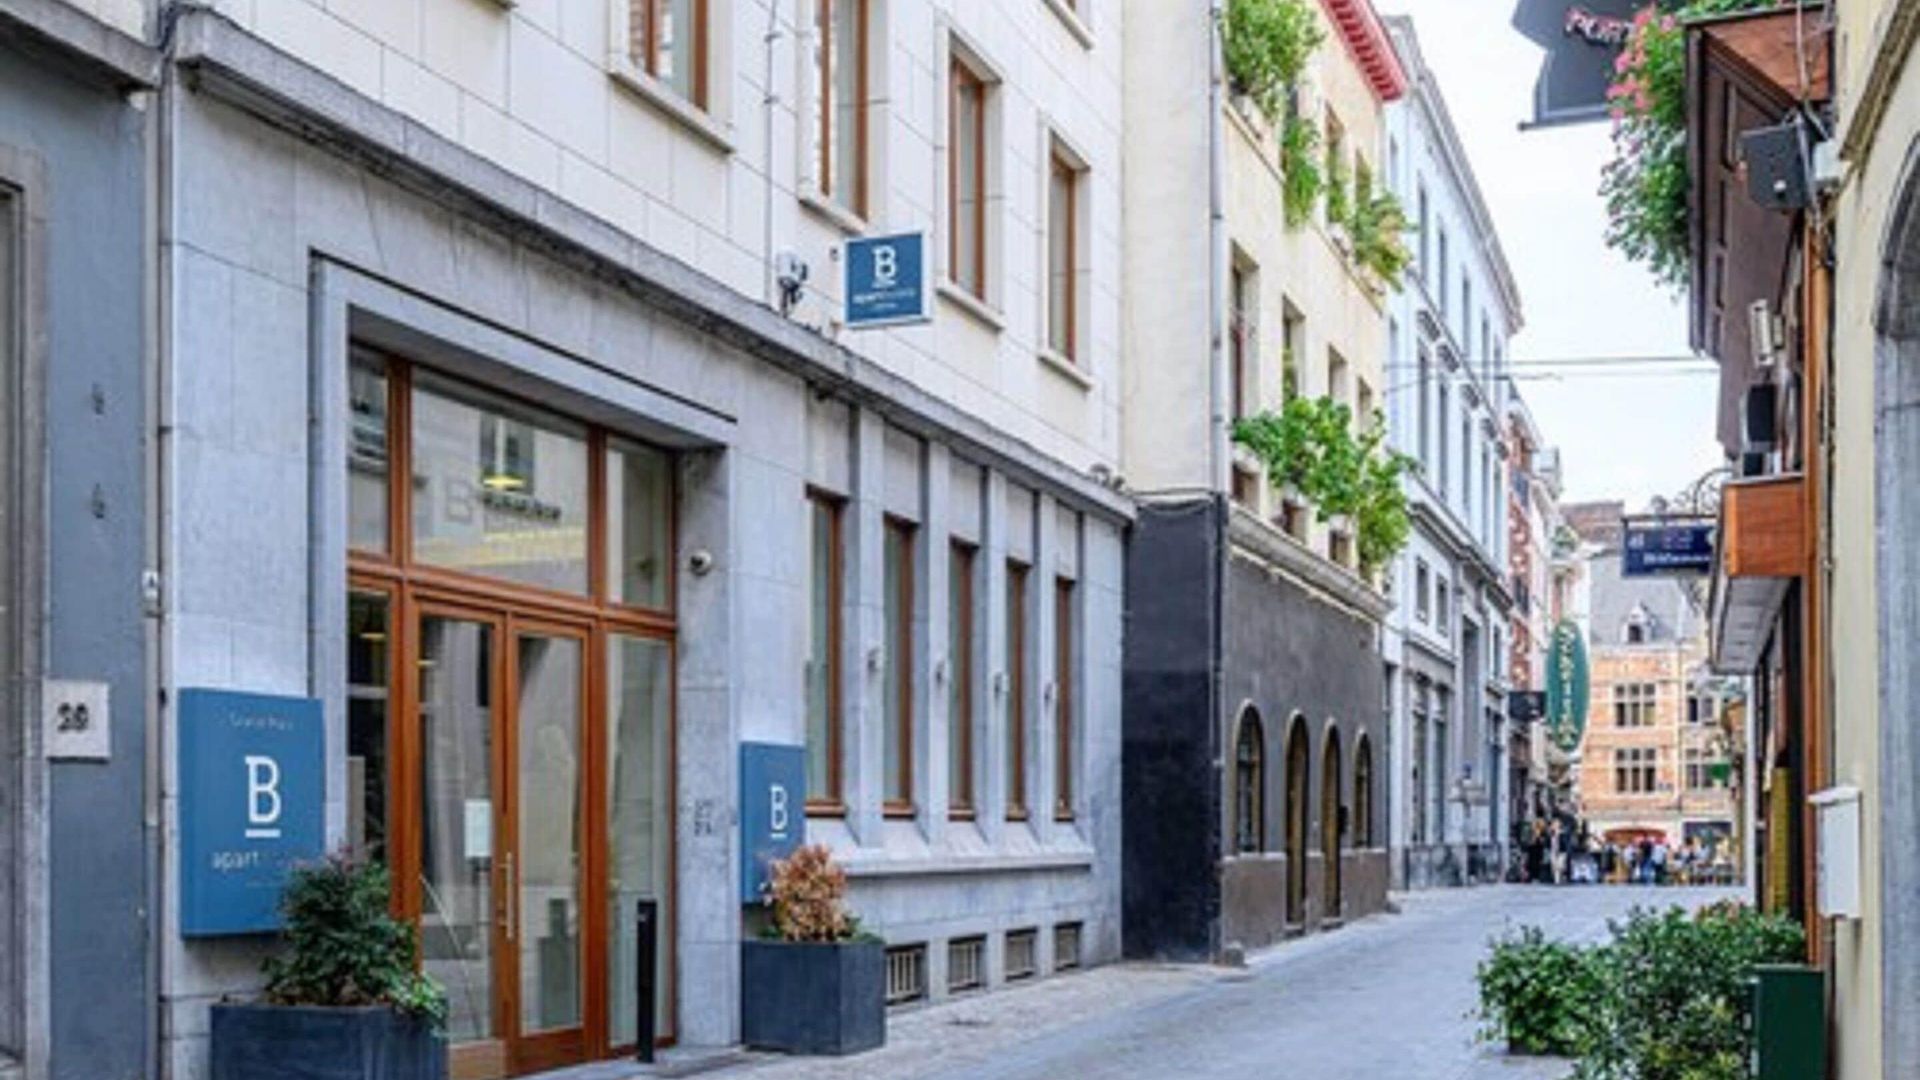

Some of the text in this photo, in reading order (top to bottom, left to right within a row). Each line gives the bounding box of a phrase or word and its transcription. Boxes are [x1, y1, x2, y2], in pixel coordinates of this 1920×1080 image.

[872, 245, 896, 279] B
[244, 755, 282, 825] B
[769, 784, 789, 831] B
